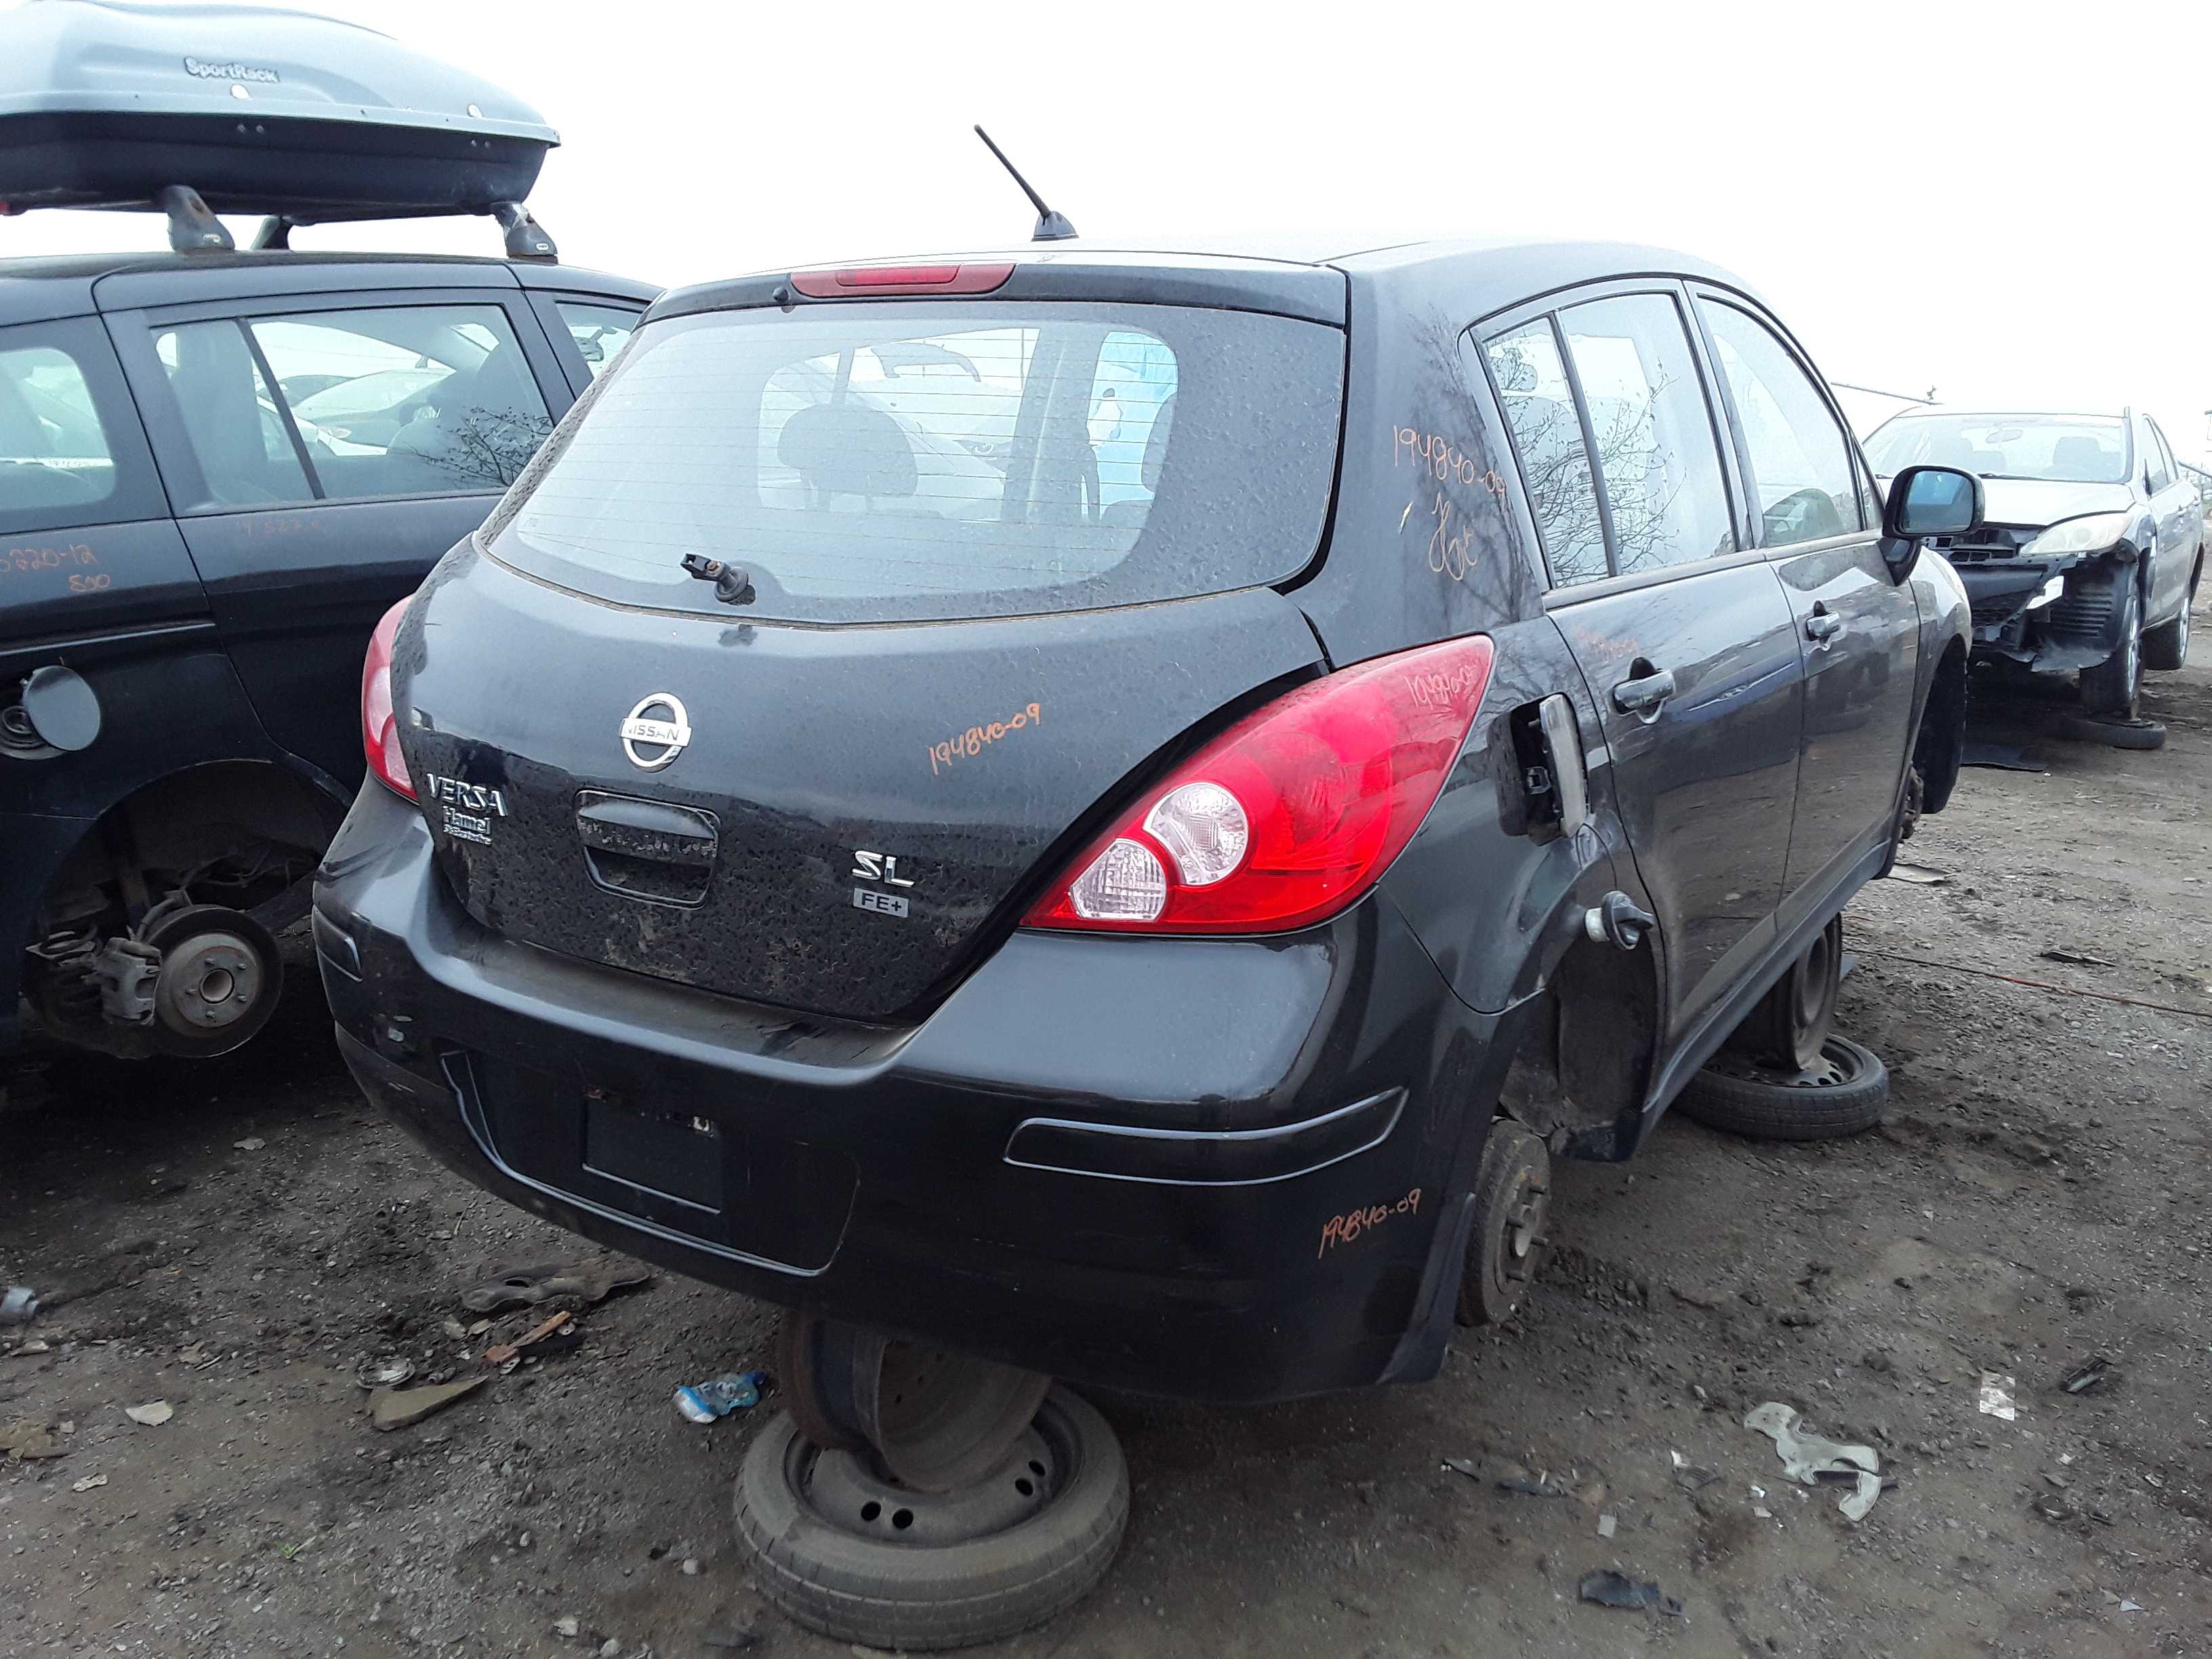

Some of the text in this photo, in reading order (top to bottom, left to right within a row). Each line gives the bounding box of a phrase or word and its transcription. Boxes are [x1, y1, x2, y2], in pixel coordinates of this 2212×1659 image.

[623, 724, 680, 741] NISSAN
[928, 702, 1041, 775] 194840-09
[426, 773, 508, 817] VERSA
[852, 851, 915, 888] SL
[861, 892, 902, 912] FE+
